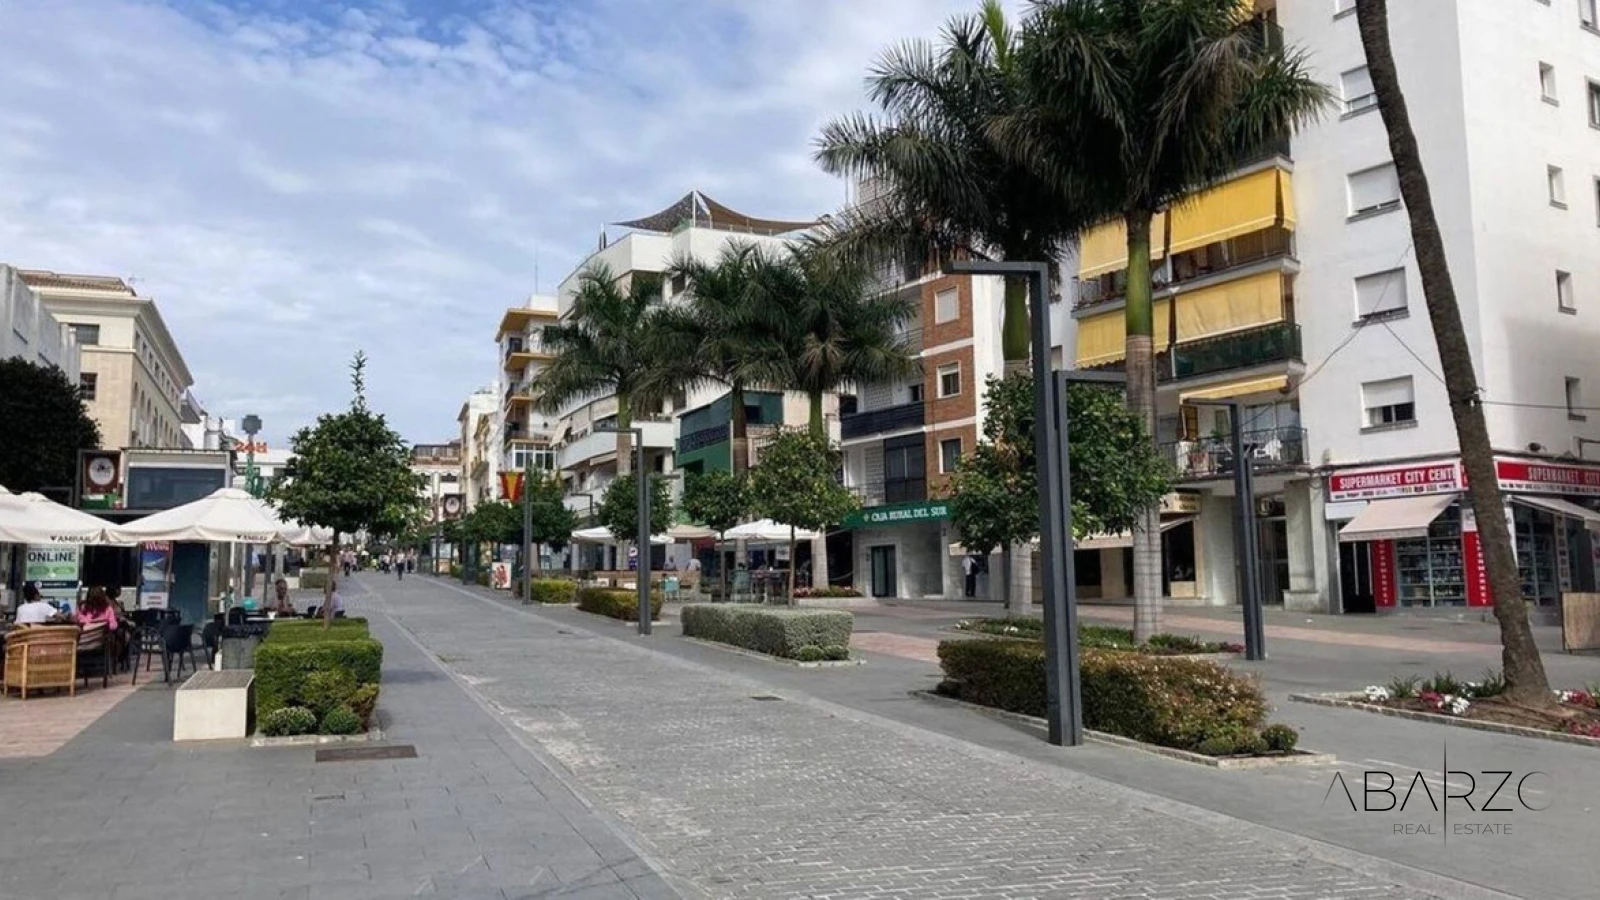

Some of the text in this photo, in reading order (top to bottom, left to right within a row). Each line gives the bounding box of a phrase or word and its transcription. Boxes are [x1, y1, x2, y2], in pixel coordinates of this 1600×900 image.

[1339, 471, 1400, 489] SUPERMARKET
[1404, 469, 1425, 484] CITY
[1528, 466, 1579, 482] SUPERMARKET
[913, 508, 929, 518] DEL
[930, 506, 947, 517] SUR
[28, 551, 76, 562] ONLINE
